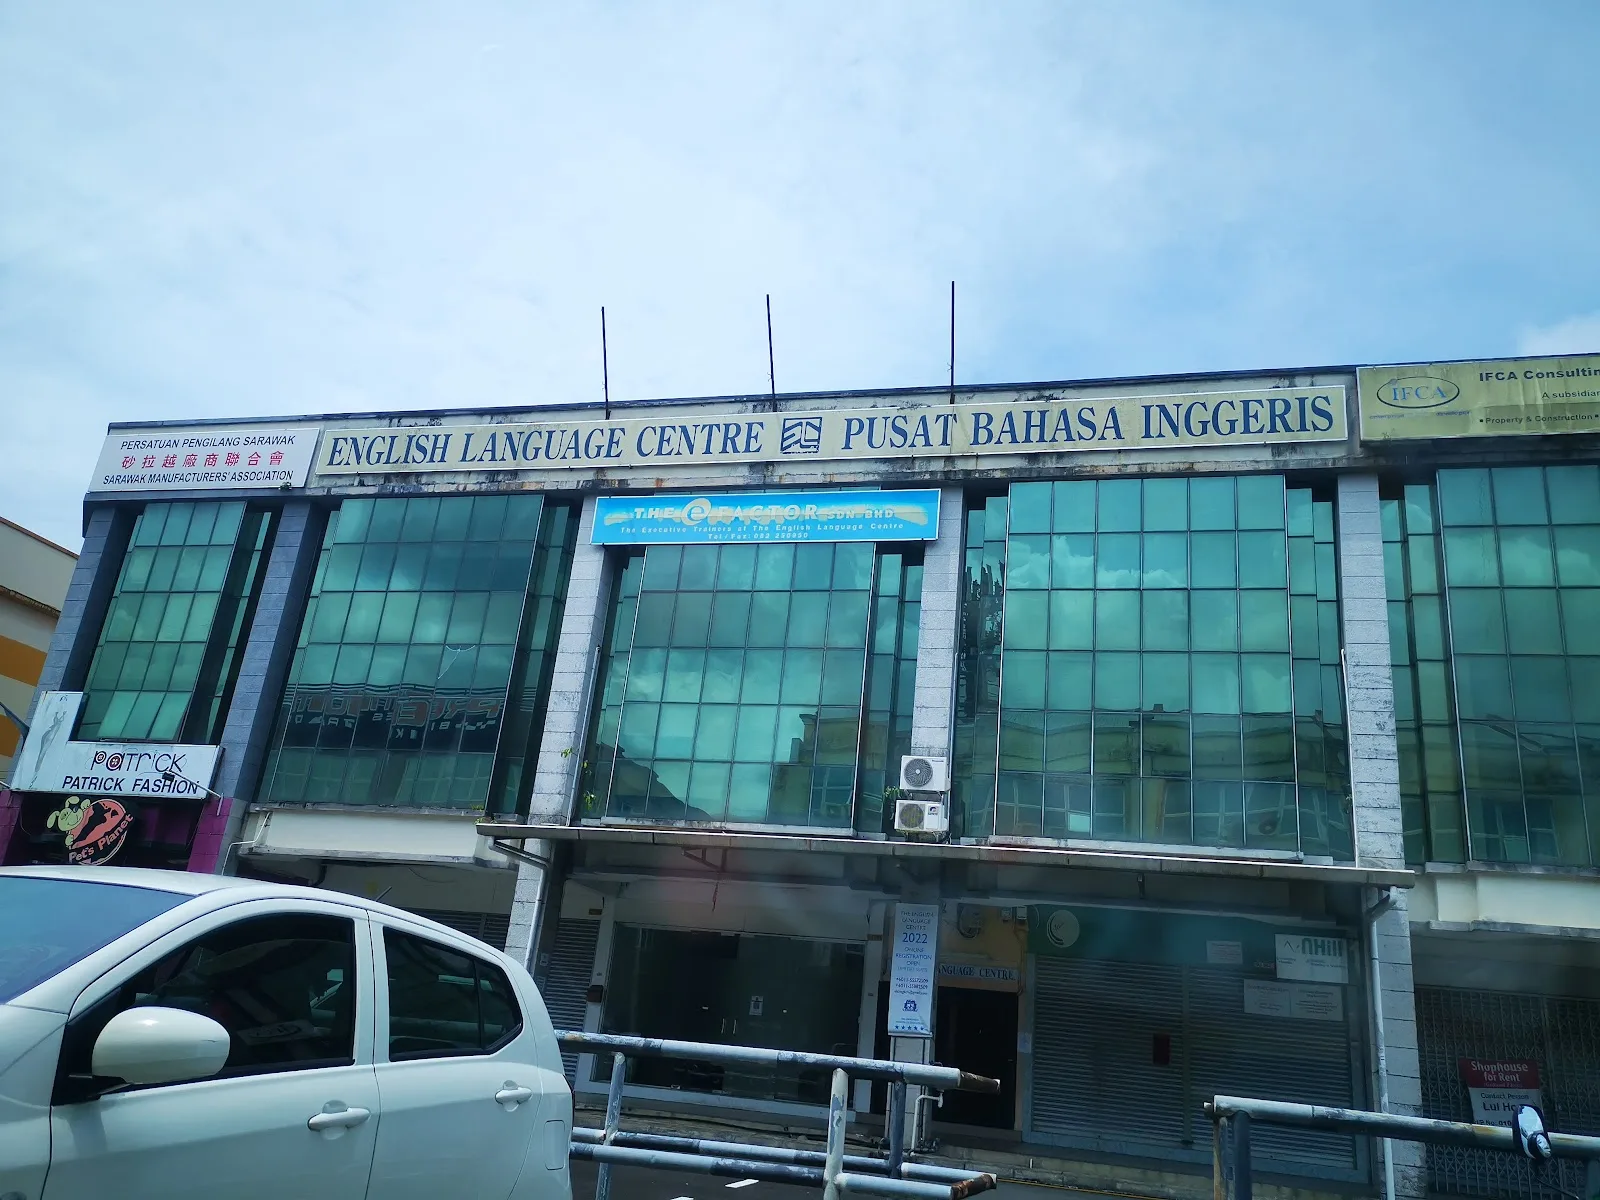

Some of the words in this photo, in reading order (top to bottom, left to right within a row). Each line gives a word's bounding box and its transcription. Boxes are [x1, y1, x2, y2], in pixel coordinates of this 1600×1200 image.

[1479, 371, 1518, 382] IFCA
[1523, 367, 1600, 380] Consultin
[1392, 386, 1447, 401] IFCA
[841, 412, 957, 451] PUSAT
[969, 405, 1125, 446] BAHASA
[1140, 394, 1334, 439] INGGERIS
[1485, 416, 1524, 425] Property
[1534, 413, 1593, 422] Construction
[120, 439, 179, 451] PERSATUAN
[181, 437, 242, 449] PENGILANG
[242, 435, 296, 447] SARAWAK
[326, 432, 453, 466] ENGLISH
[458, 426, 626, 463] LANGUAGE
[636, 421, 765, 458] CENTRE
[121, 450, 285, 469] 砂拉越廠商聯合會
[102, 473, 147, 485] SARAWAK
[148, 471, 230, 484] MANUFACTURERS'
[230, 469, 294, 482] ASSOCIATION
[633, 507, 675, 519] THE
[717, 504, 818, 520] FACTOR
[828, 510, 856, 519] SDN
[865, 509, 894, 519] BHD
[776, 524, 811, 532] English
[817, 523, 863, 531] Language
[62, 775, 126, 792] PATRICK
[131, 778, 199, 795] FASHION
[68, 846, 95, 863] Pet's
[97, 812, 134, 851] Planet
[902, 932, 928, 944] 2022
[1470, 1060, 1529, 1074] Shophouse
[1483, 1072, 1499, 1082] for
[1500, 1073, 1520, 1082] Rent
[1481, 1092, 1506, 1100] Contact
